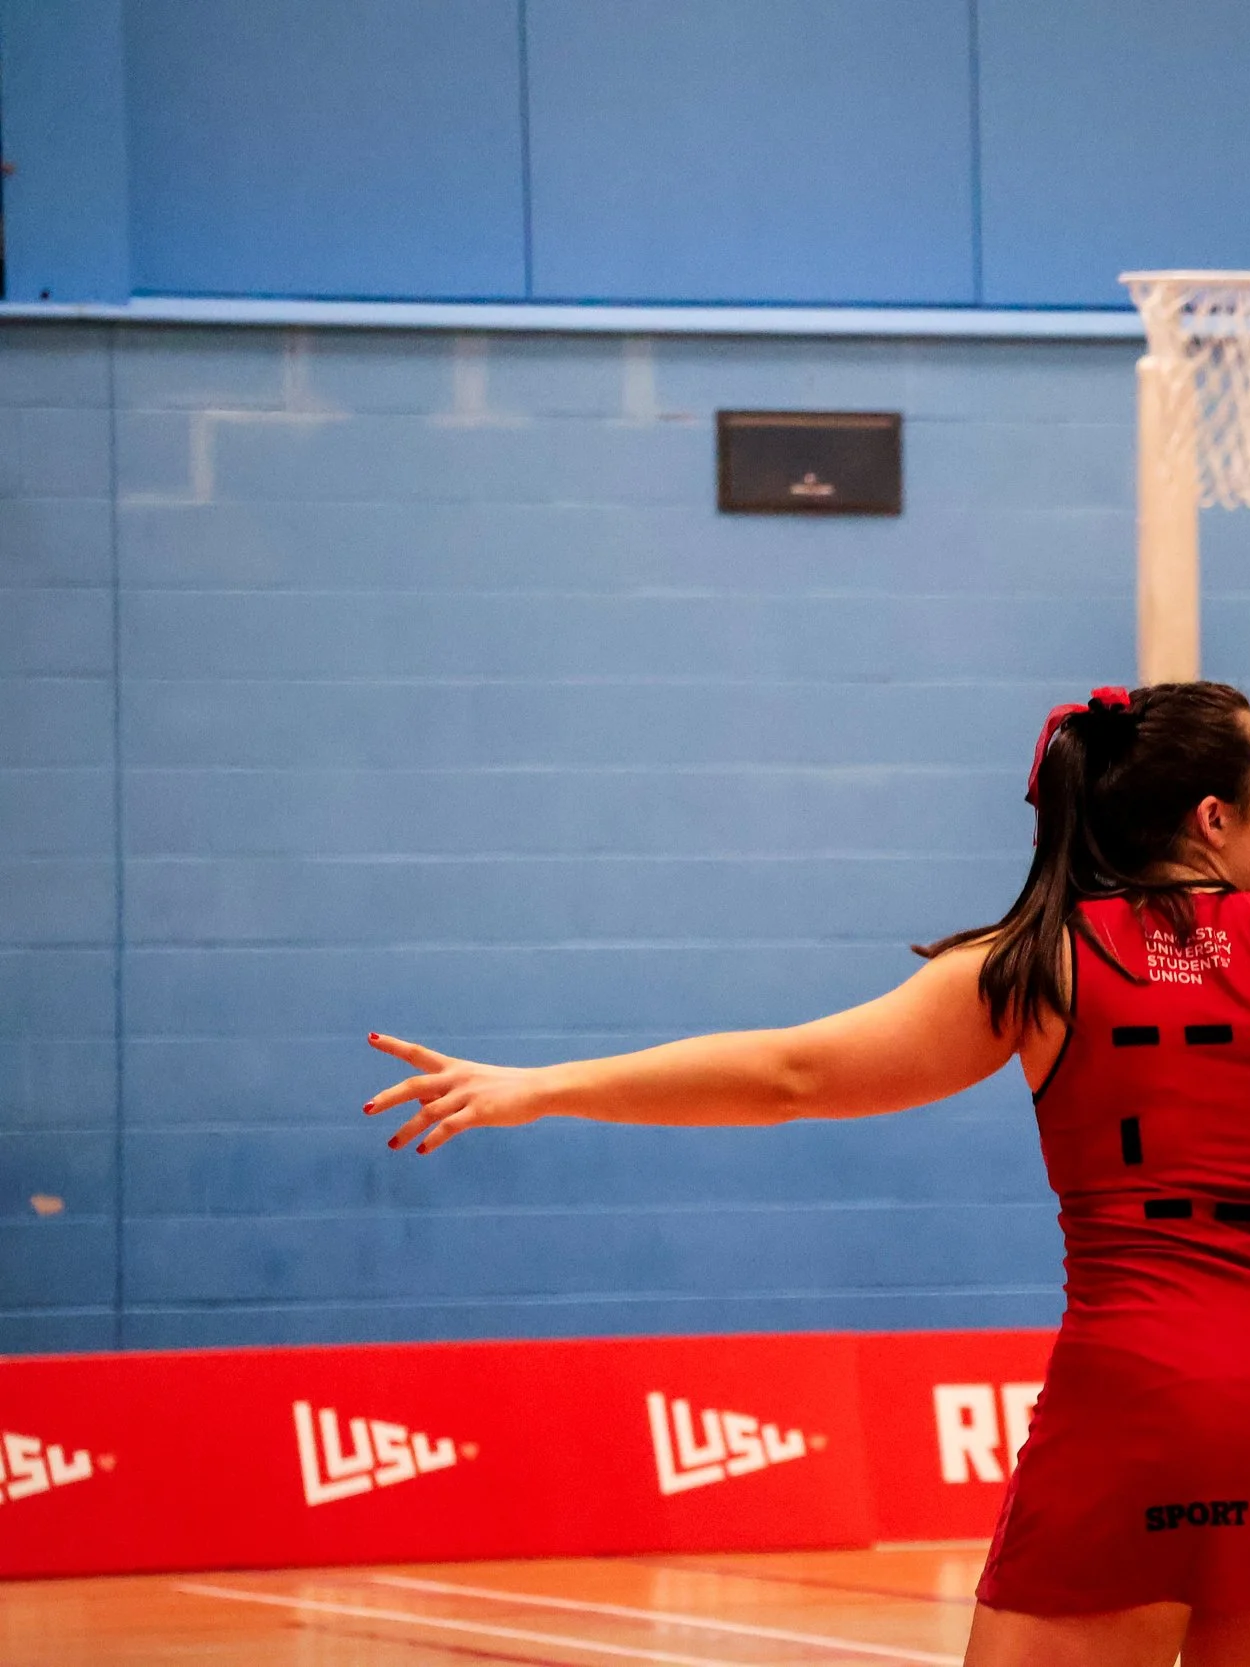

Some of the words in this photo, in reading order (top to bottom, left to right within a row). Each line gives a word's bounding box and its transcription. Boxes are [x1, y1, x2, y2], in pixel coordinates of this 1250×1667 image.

[1145, 927, 1227, 943] ANSTR
[1149, 969, 1203, 985] UNION
[0, 1432, 93, 1505] SU
[1145, 1501, 1248, 1532] SPORT
